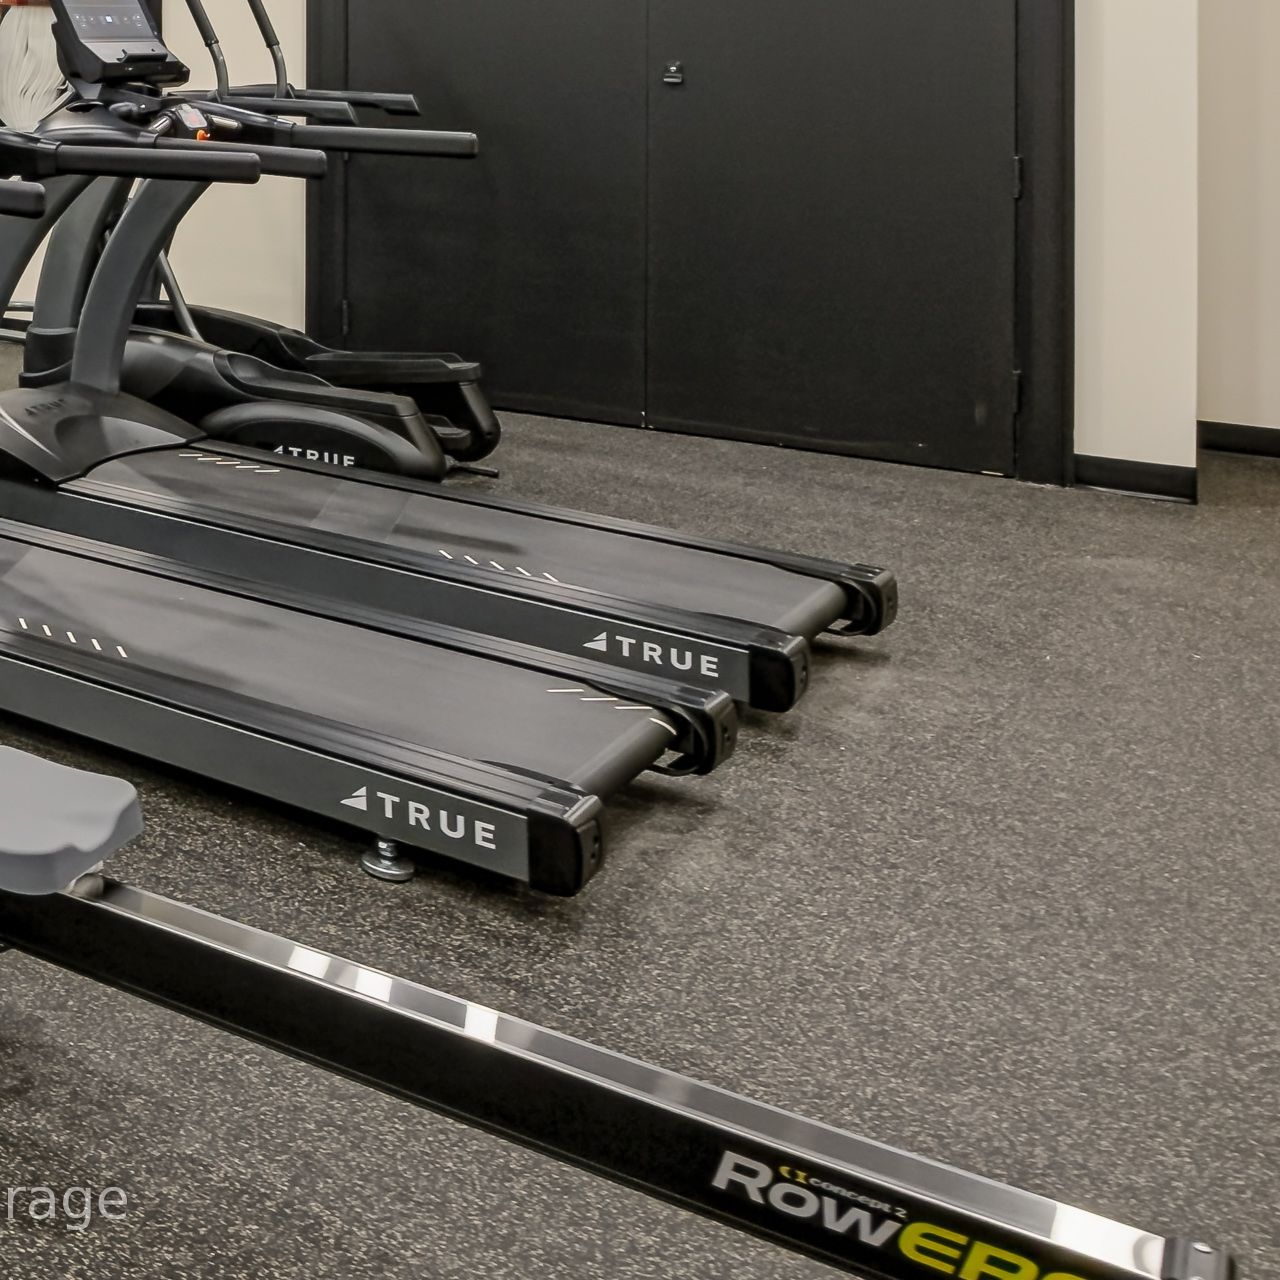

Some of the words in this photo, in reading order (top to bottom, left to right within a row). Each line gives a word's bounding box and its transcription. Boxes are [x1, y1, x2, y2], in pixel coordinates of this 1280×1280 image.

[615, 635, 719, 678] TRUE
[376, 791, 497, 850] TRUE
[711, 1150, 1088, 1280] ROWER
[809, 1176, 892, 1212] concept
[895, 1205, 908, 1219] 2
